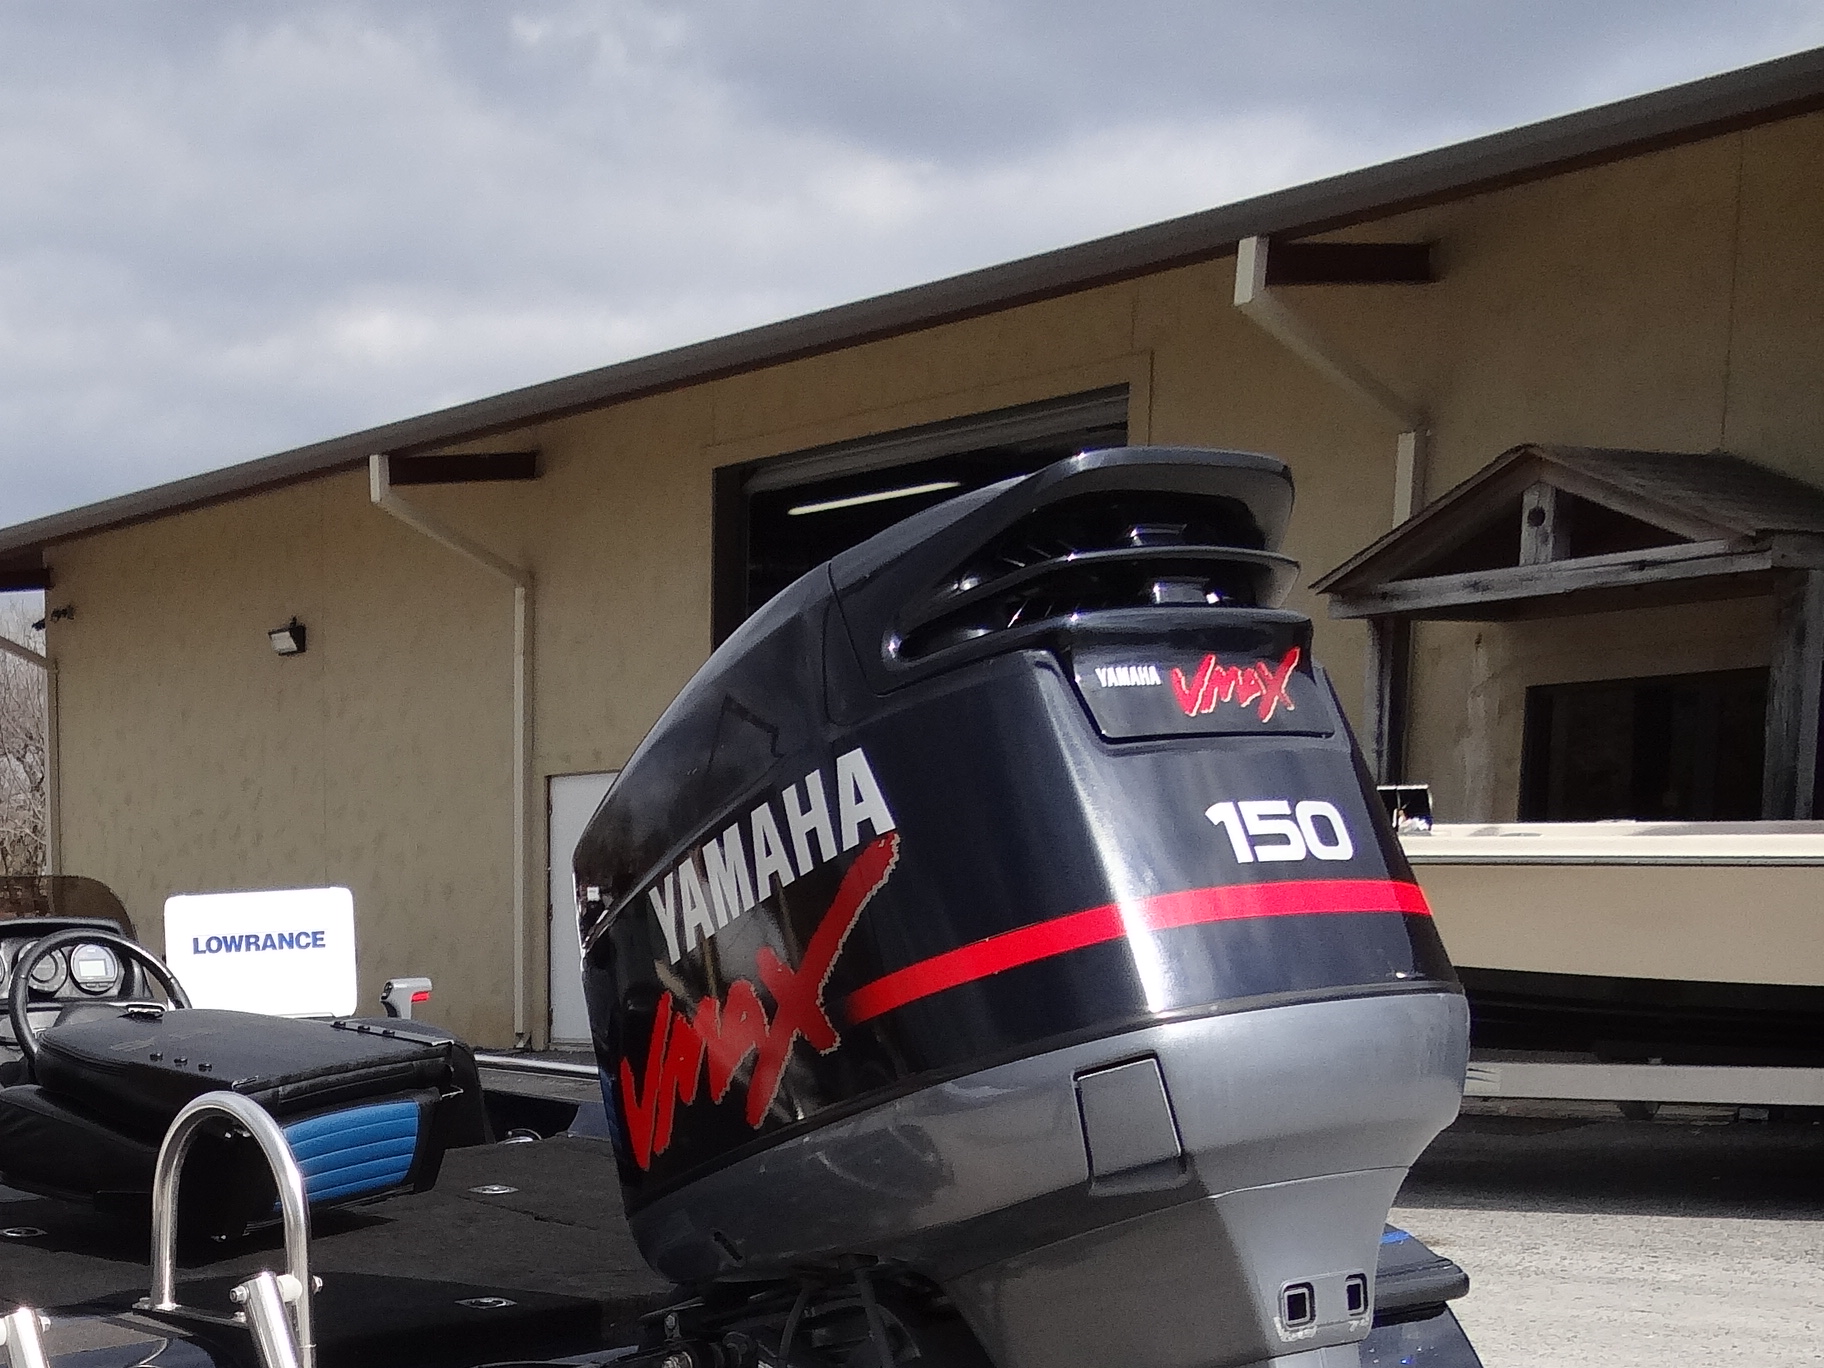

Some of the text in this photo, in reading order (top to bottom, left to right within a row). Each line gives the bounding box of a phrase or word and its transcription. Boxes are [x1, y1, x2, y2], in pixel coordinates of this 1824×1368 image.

[1095, 665, 1162, 688] YAMAHA
[1204, 800, 1355, 864] 150
[647, 746, 897, 966] YAMAHA
[192, 930, 327, 956] LOWRANCE
